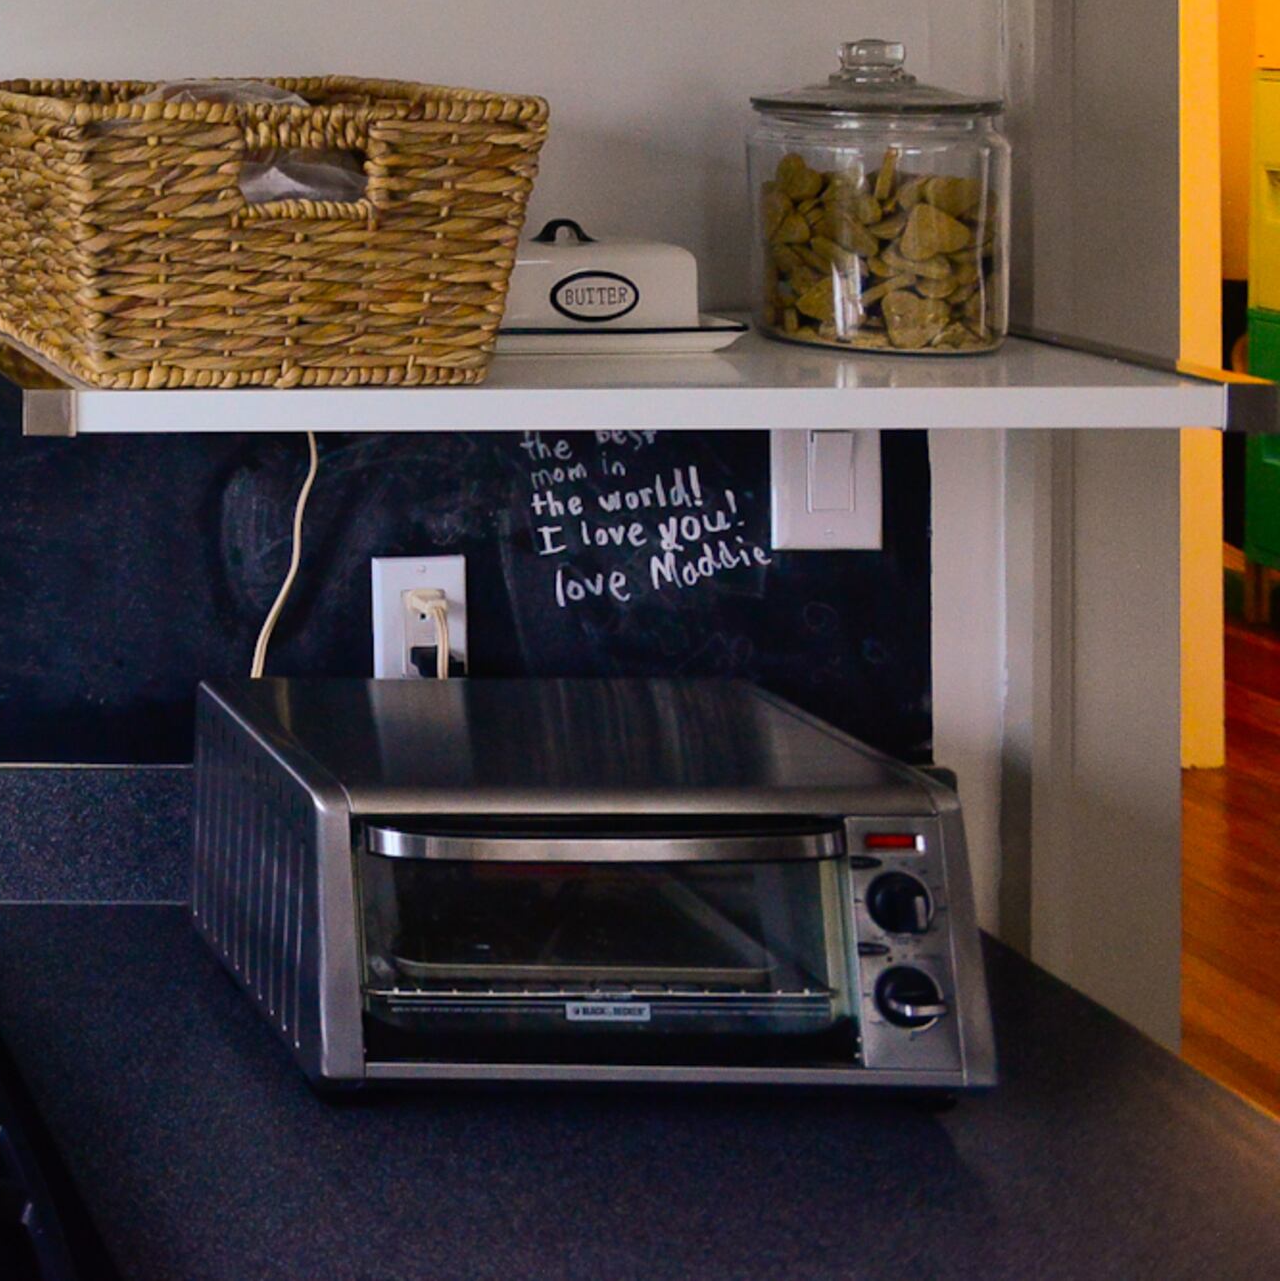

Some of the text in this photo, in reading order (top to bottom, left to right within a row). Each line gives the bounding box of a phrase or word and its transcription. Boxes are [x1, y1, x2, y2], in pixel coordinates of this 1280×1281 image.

[565, 286, 629, 306] BUTTER
[520, 430, 572, 461] the
[531, 452, 627, 489] mom in
[531, 466, 703, 517] the world!
[537, 489, 745, 555] I love you!
[555, 536, 773, 607] love Maddie
